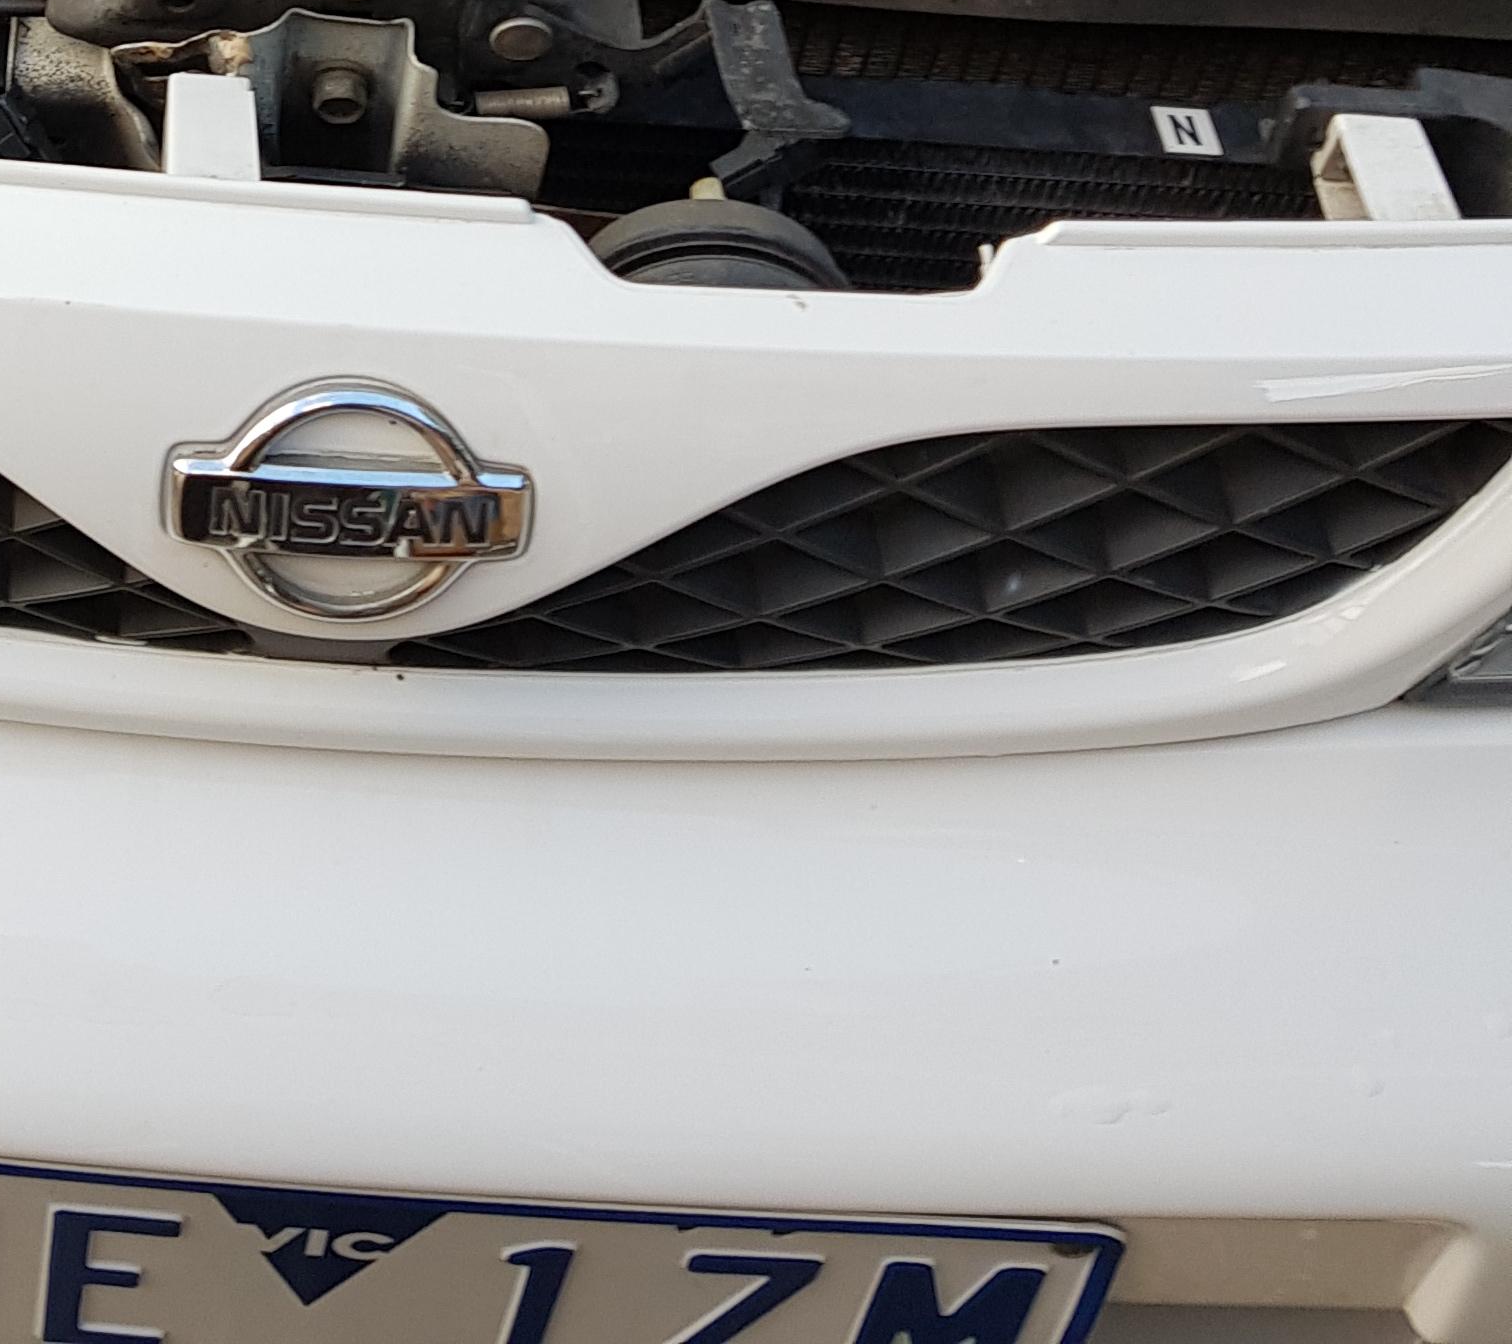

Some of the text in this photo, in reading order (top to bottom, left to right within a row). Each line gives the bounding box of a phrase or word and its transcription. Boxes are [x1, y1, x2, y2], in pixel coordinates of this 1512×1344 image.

[1170, 115, 1200, 147] N
[209, 487, 501, 549] NISSAN
[251, 1224, 396, 1262] VIC
